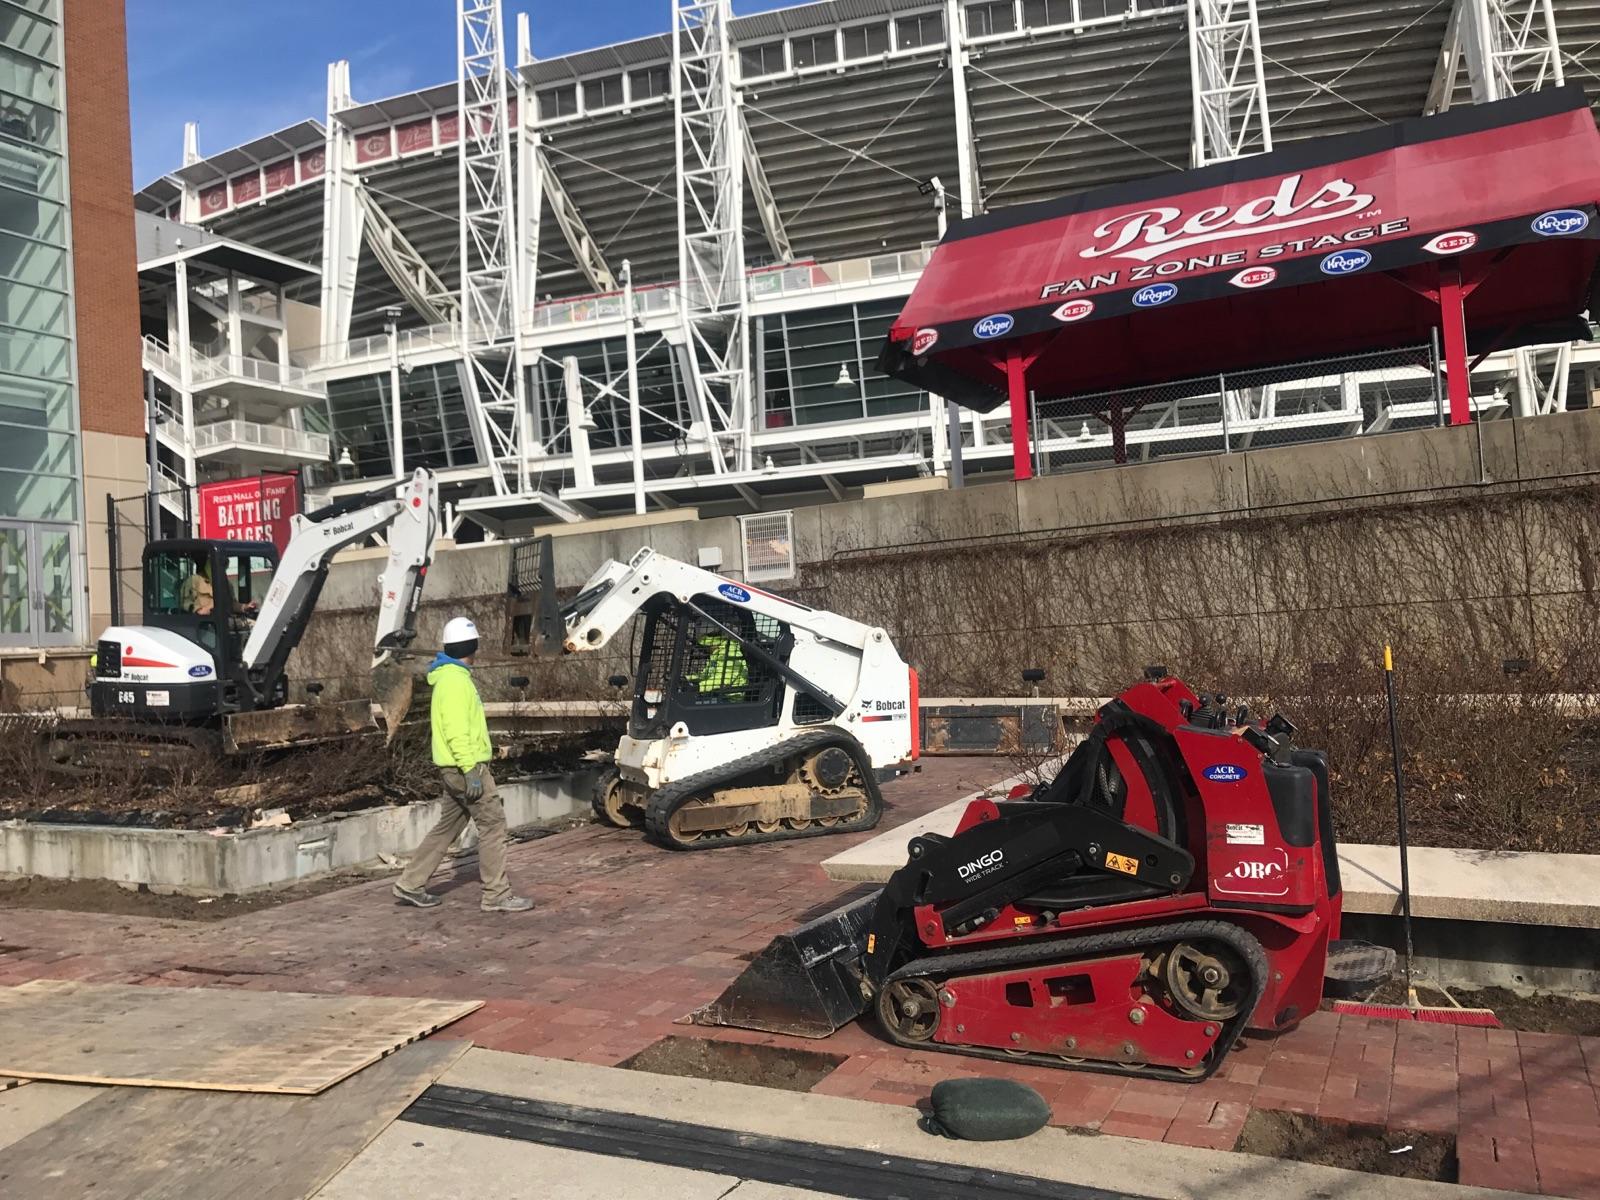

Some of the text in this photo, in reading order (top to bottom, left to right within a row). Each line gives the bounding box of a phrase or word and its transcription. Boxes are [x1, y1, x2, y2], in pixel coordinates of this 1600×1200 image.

[1079, 174, 1375, 261] Reds
[1538, 216, 1583, 232] Kroger
[1438, 236, 1477, 249] REDS
[1039, 217, 1410, 299] FAN ZONE STAGE
[1326, 254, 1367, 271] Kroger
[1243, 271, 1277, 283] REDS
[1138, 287, 1174, 303] Kroger
[1064, 304, 1094, 317] REDS
[978, 319, 1010, 335] Kroger
[233, 492, 254, 501] HALL
[266, 486, 287, 496] FAME
[217, 498, 281, 527] BATTING
[875, 700, 906, 711] Bobcat
[1214, 766, 1236, 774] ACR
[957, 849, 1004, 878] DINGO
[965, 872, 982, 884] WIDE
